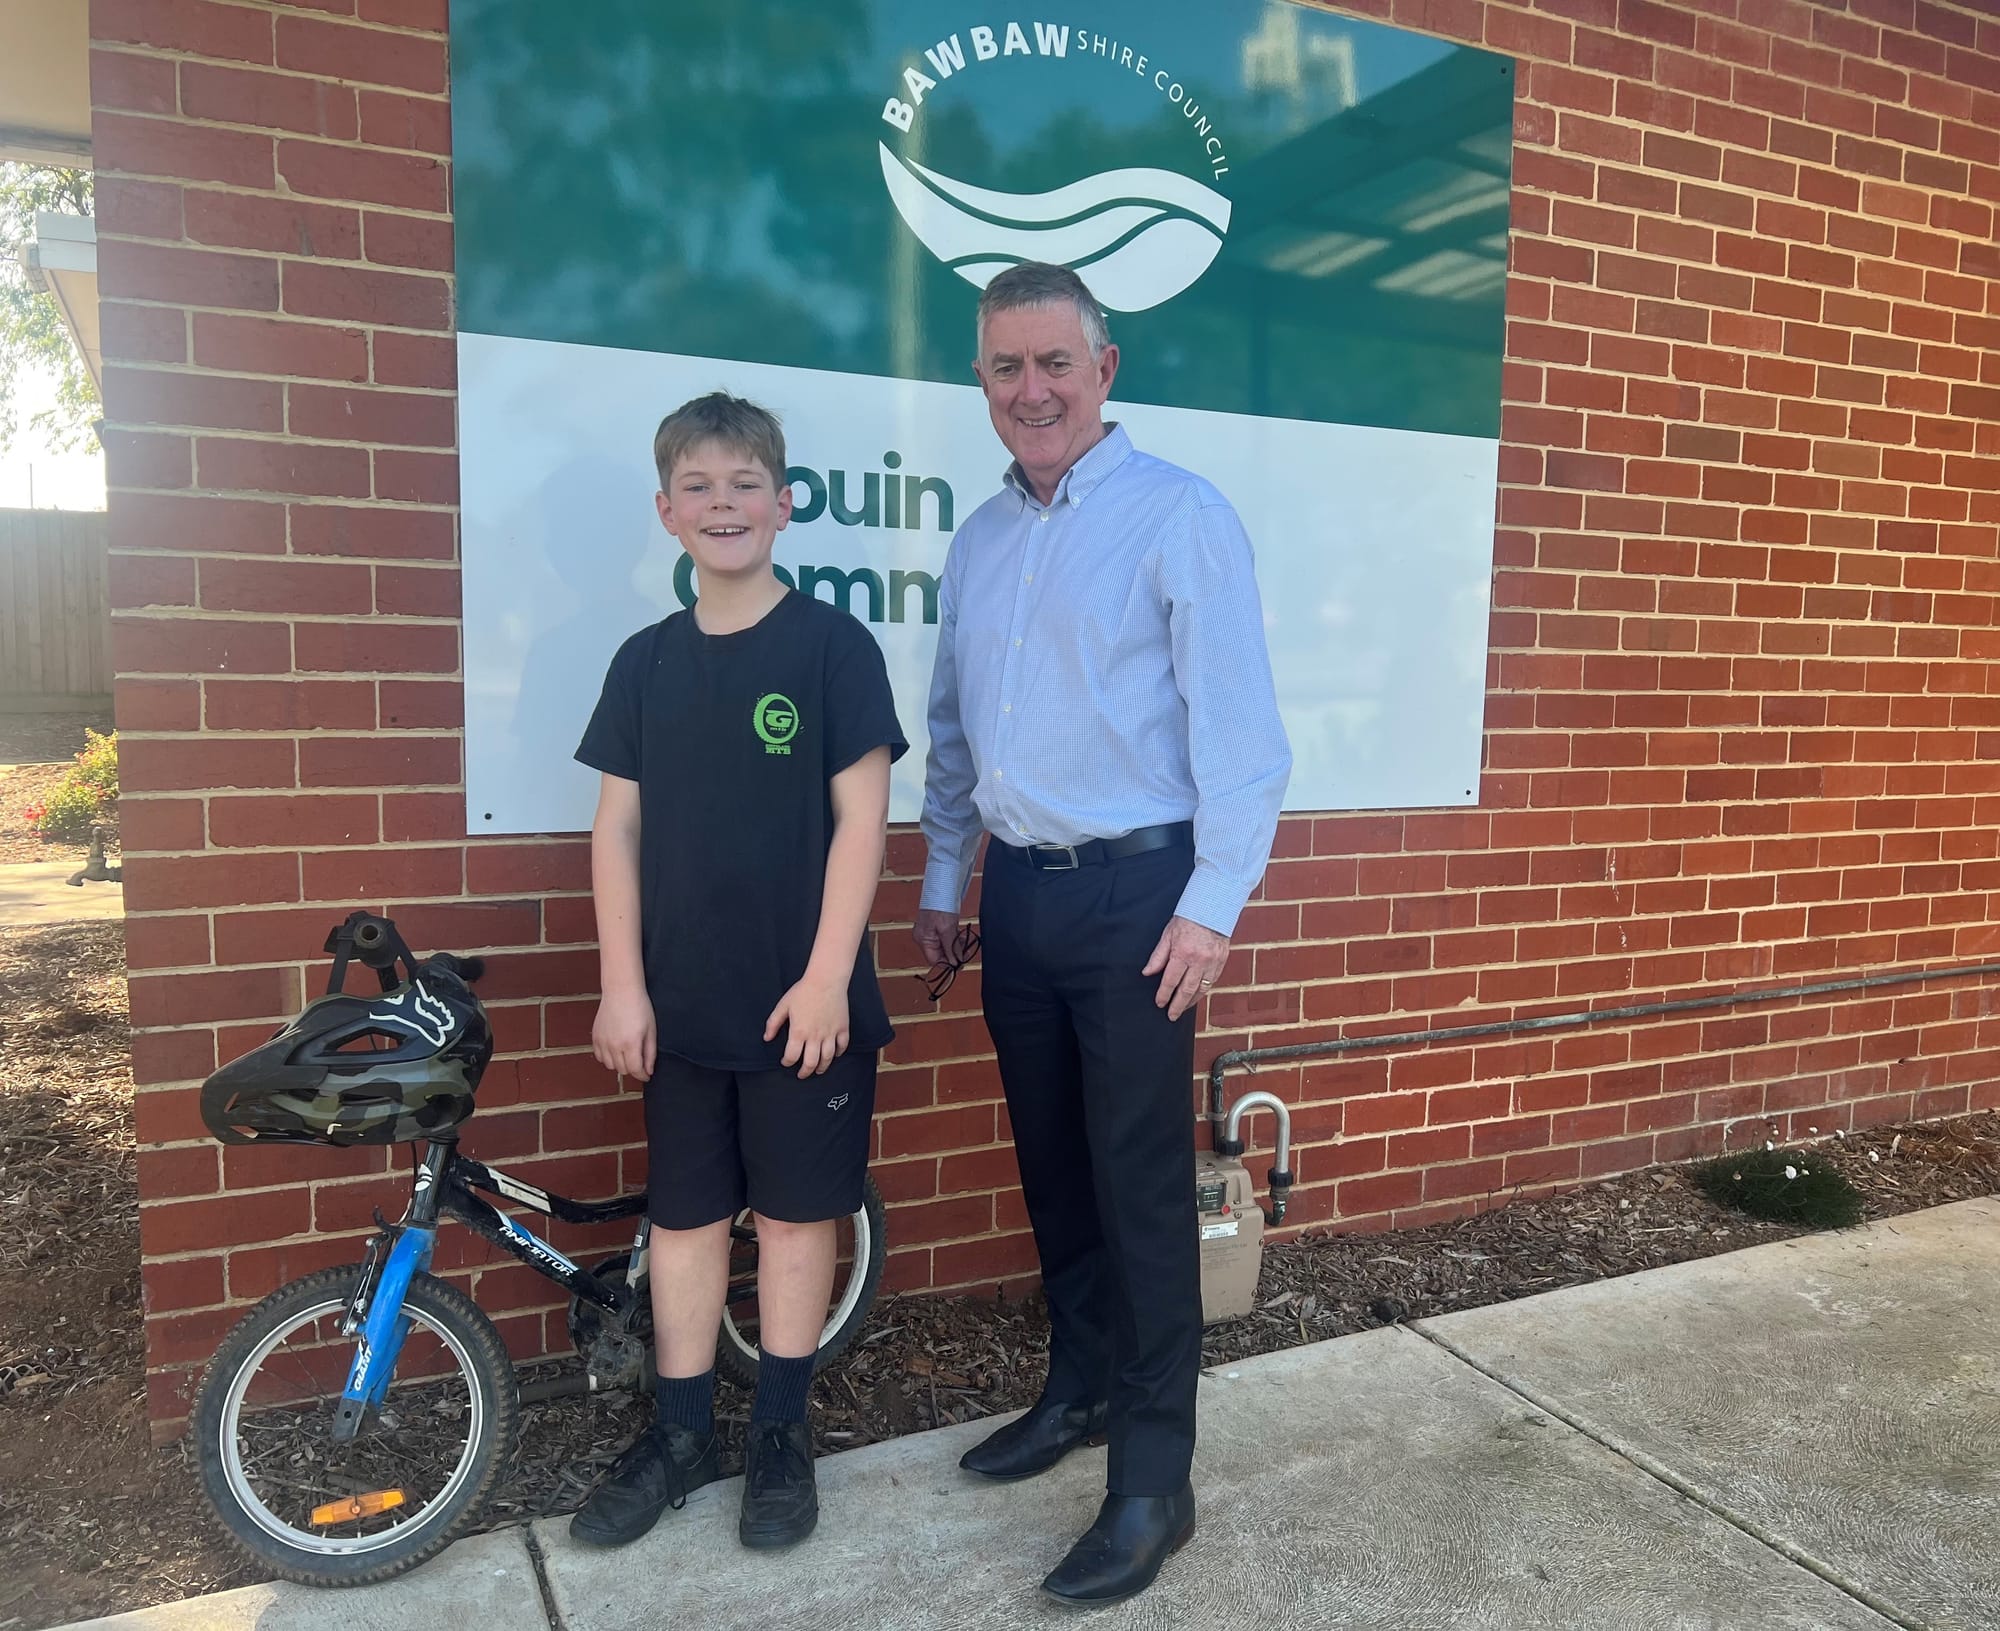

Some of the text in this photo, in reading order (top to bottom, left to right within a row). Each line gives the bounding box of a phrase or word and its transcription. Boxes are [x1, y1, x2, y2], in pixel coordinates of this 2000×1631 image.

[882, 22, 1230, 181] BAW BAW SHIRE COUNCIL
[786, 450, 954, 532] ouin
[498, 1225, 574, 1276] ANIMATOR
[353, 1345, 374, 1392] GIANT
